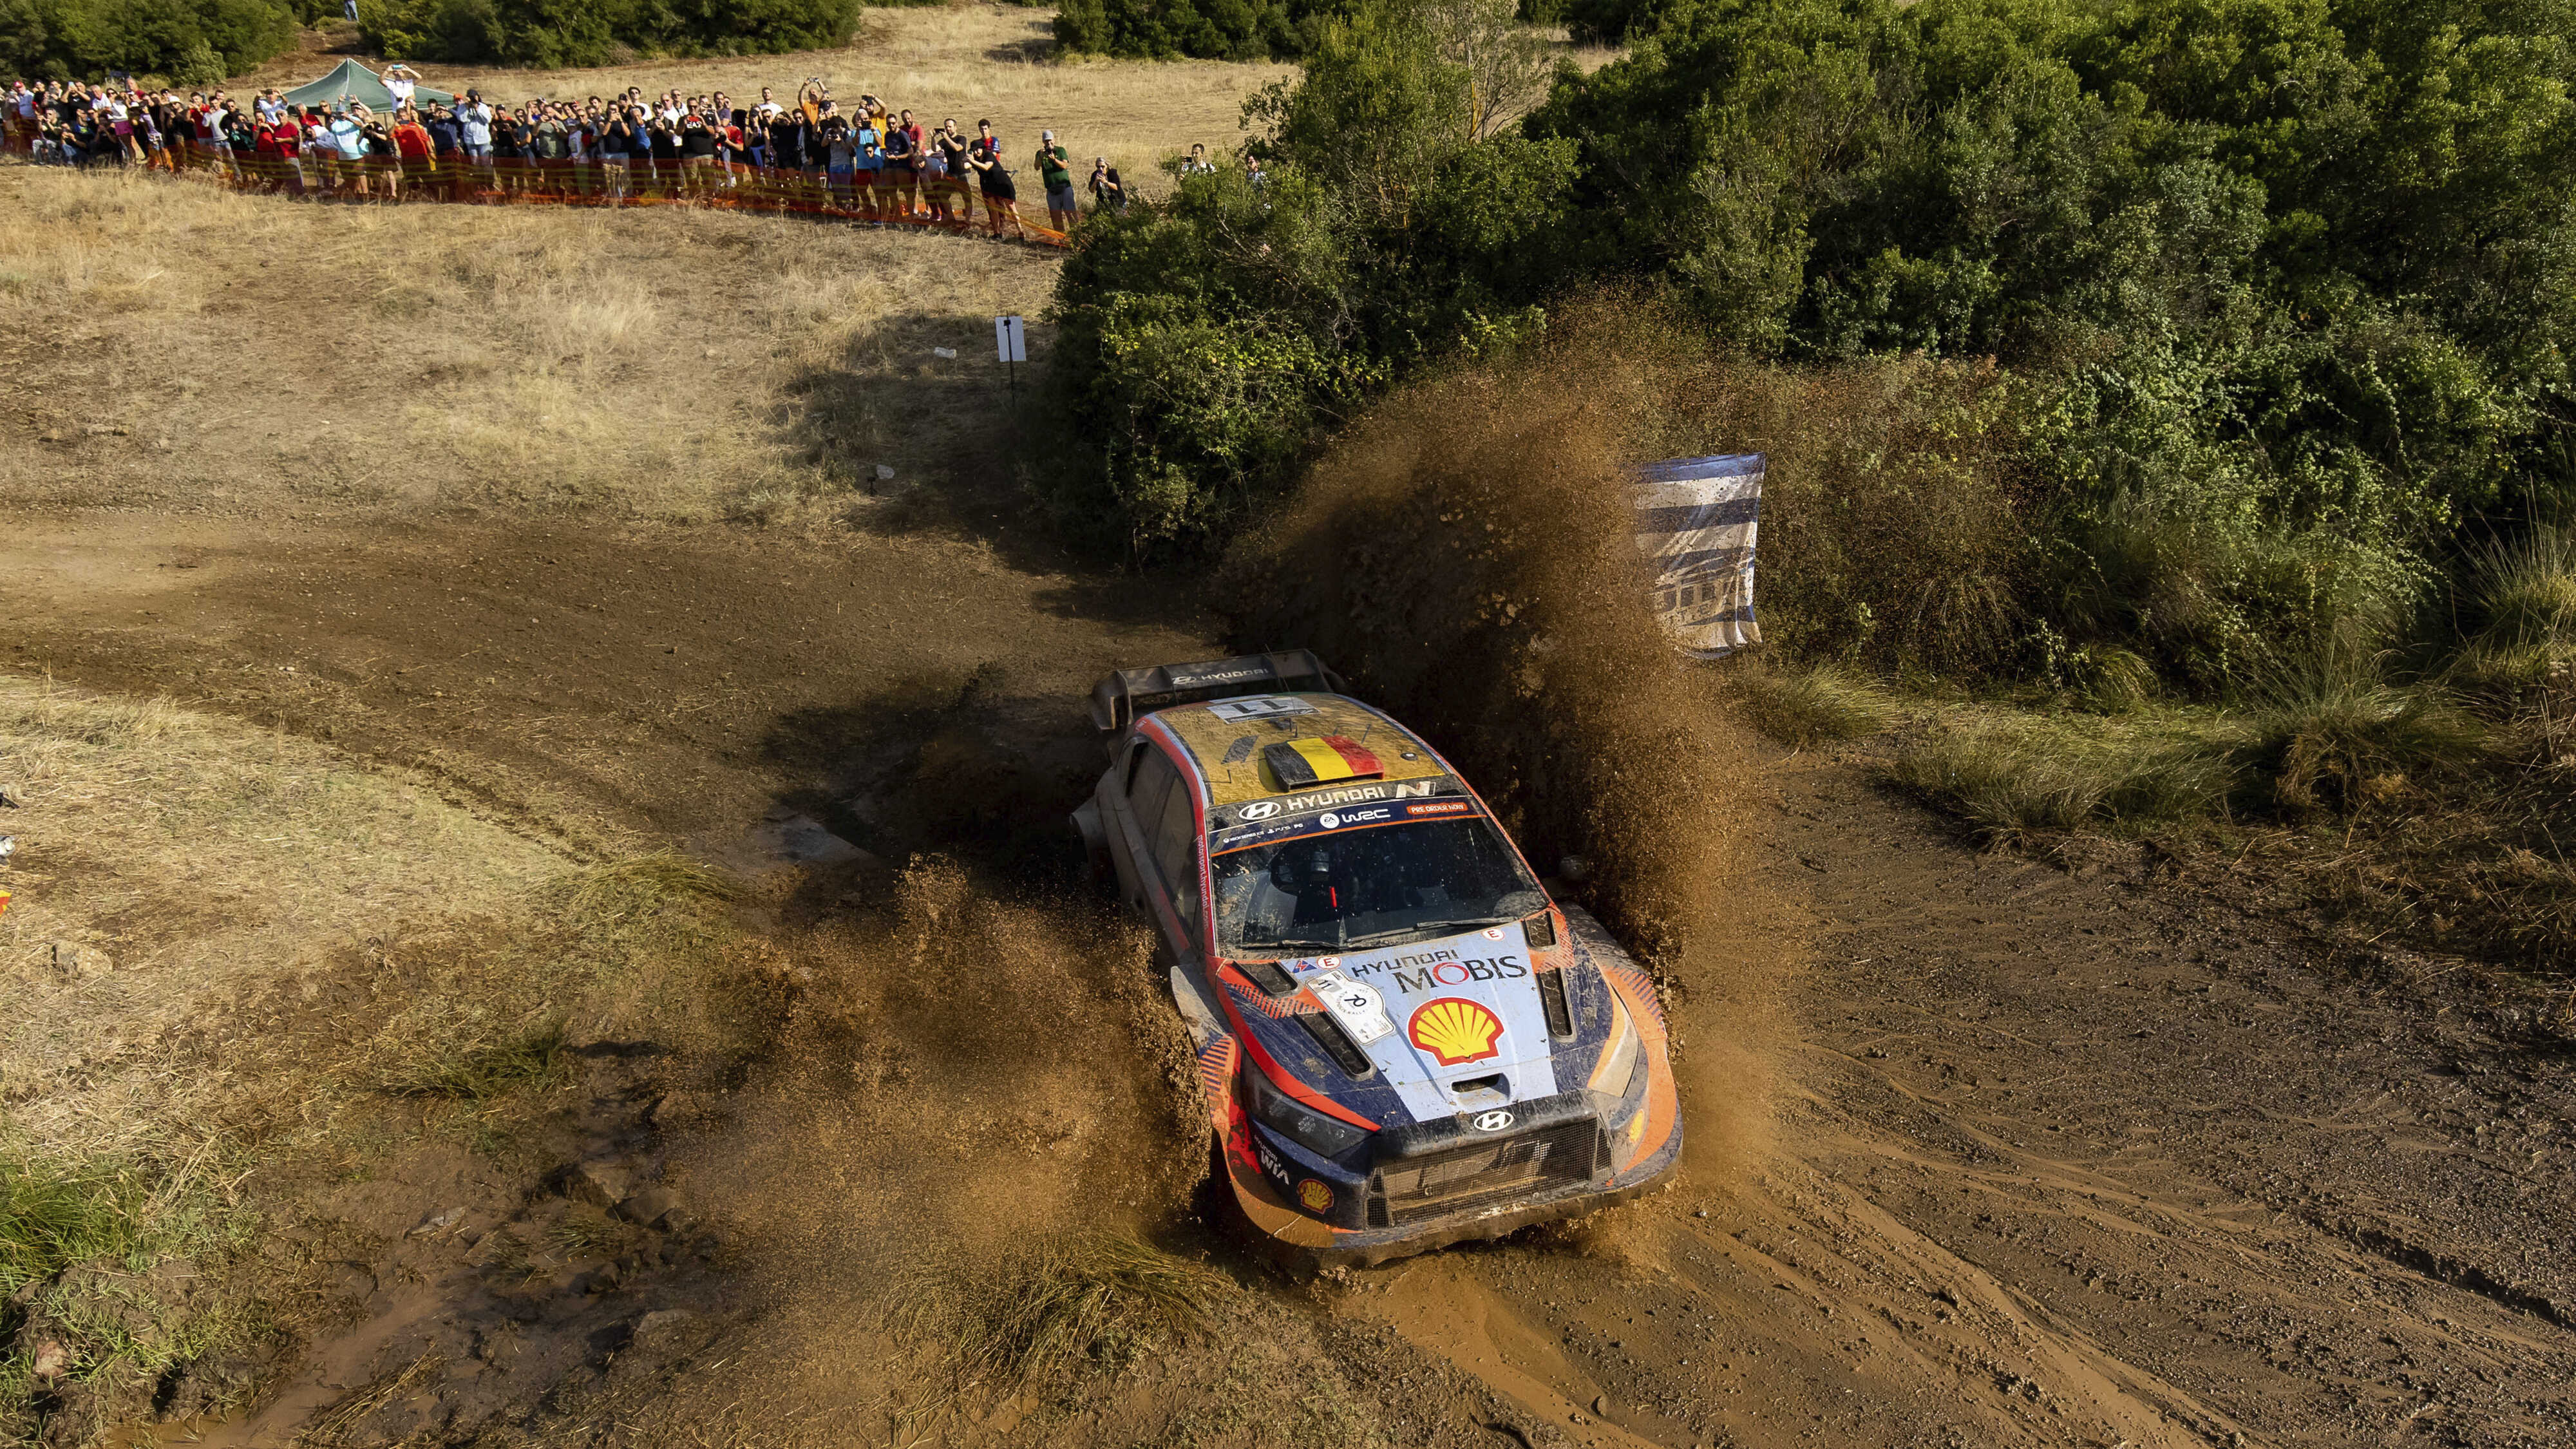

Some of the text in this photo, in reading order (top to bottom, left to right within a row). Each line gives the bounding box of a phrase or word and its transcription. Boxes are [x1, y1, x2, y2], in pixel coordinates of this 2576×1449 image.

[1201, 668, 1268, 681] HYUNDAI
[1287, 786, 1386, 811] HYUNDAI
[1341, 808, 1391, 823] WRC
[1488, 930, 1501, 938] E
[1323, 958, 1335, 967] E
[1351, 949, 1459, 978] HYUNDAI
[1392, 955, 1528, 994] MOBIS
[1254, 1134, 1278, 1162] HYUNDAI
